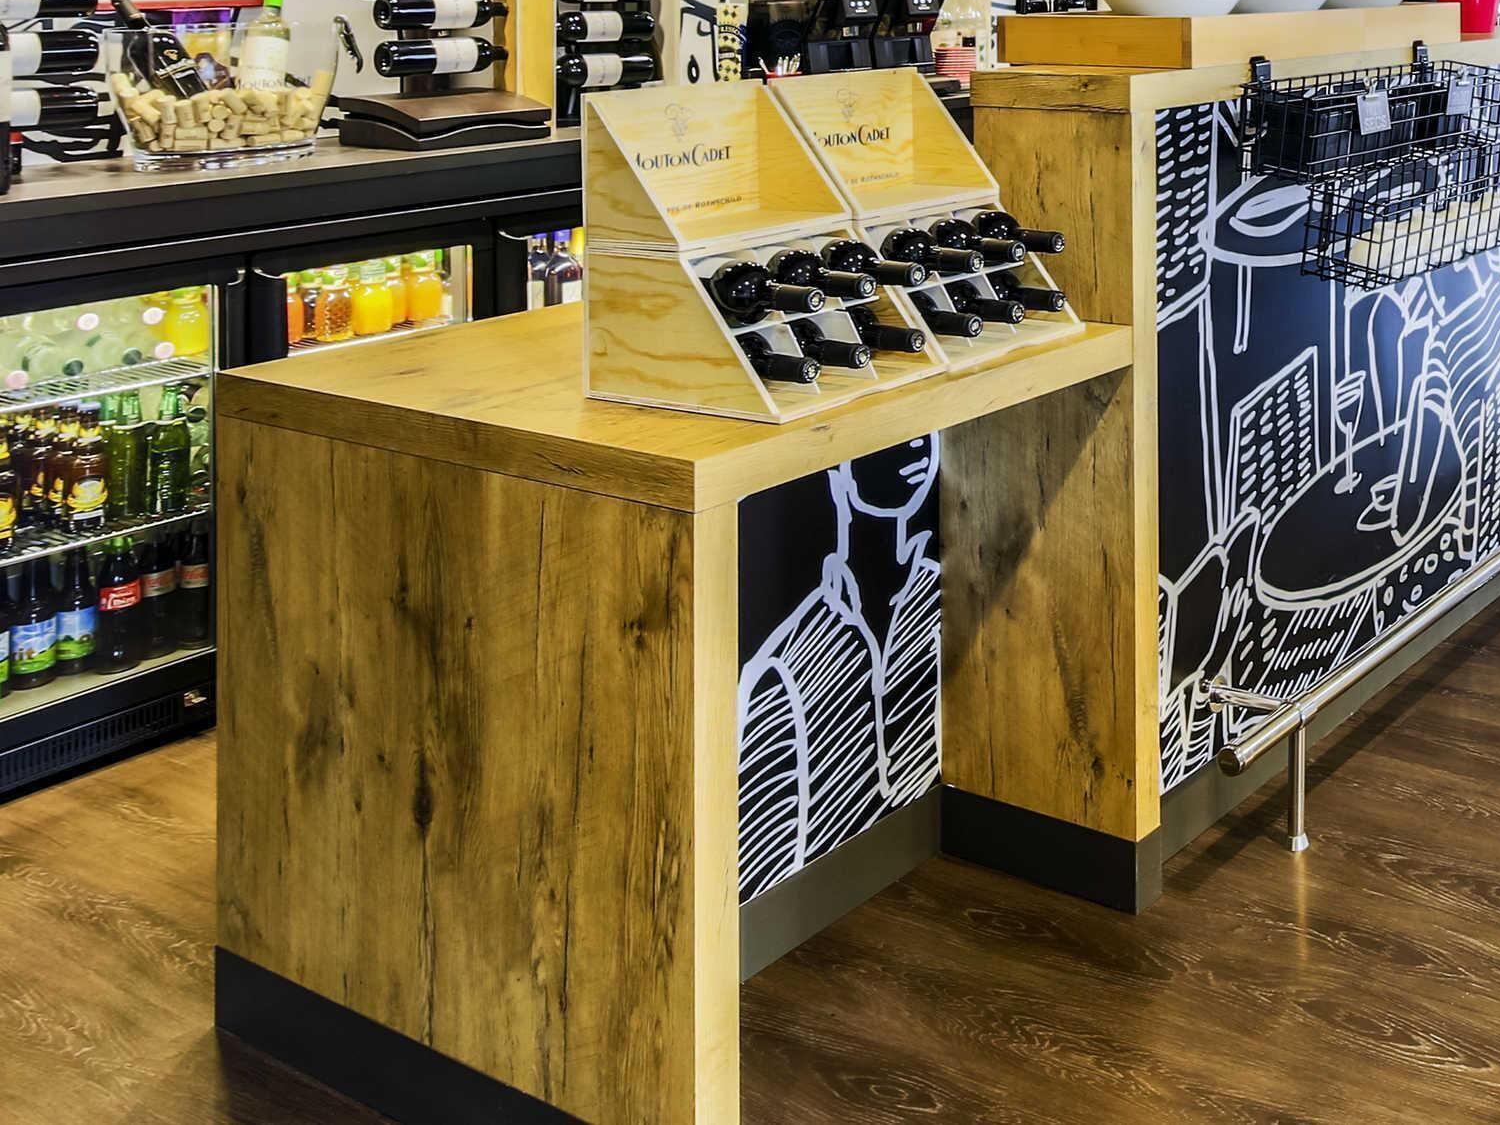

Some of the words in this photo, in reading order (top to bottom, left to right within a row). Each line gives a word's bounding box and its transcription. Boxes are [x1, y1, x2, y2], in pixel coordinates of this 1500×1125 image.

[813, 131, 857, 147] OUTON
[858, 123, 890, 146] CADET
[691, 143, 732, 167] CADET
